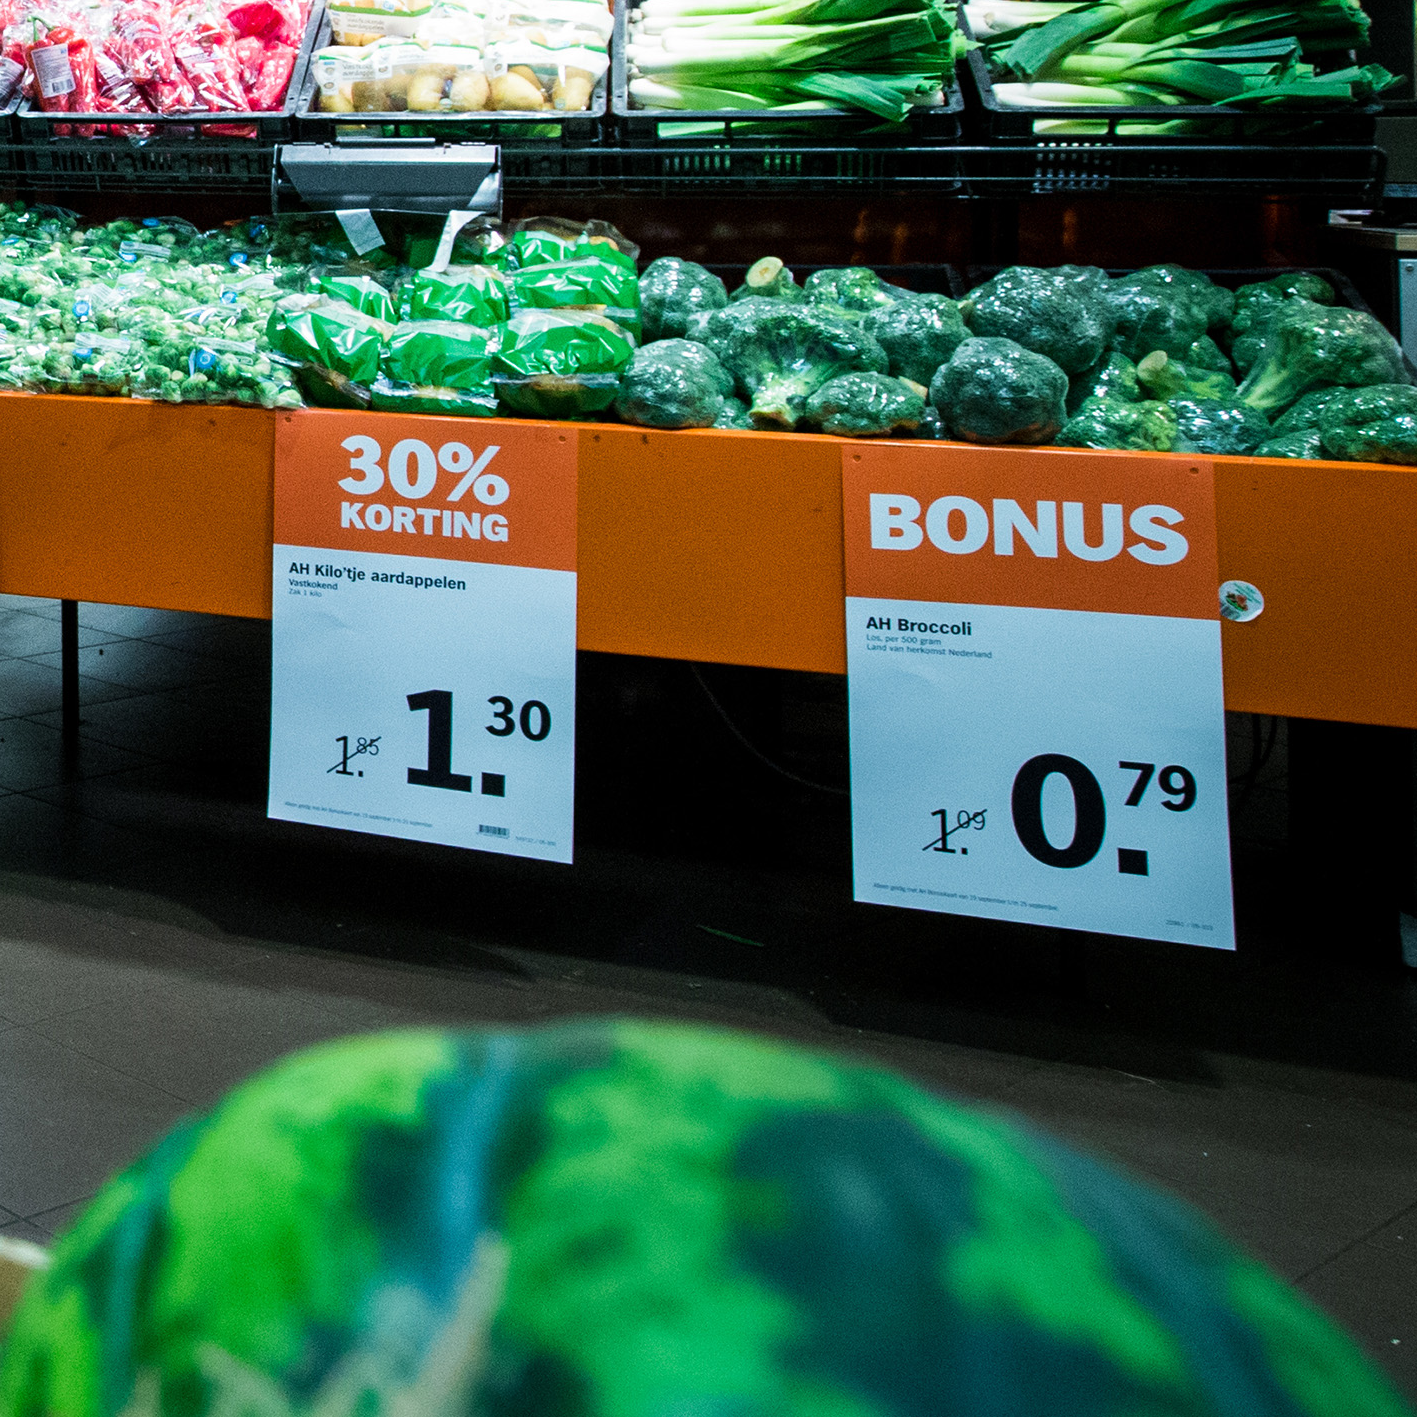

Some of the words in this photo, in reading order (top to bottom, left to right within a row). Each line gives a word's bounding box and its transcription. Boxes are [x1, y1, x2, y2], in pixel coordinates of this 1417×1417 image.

[337, 435, 510, 506] 30%
[340, 501, 510, 543] KORTING
[869, 492, 1189, 566] BONUS
[288, 578, 338, 590] Vastkokend
[289, 562, 309, 575] AH
[371, 572, 466, 590] aardappelen
[866, 616, 891, 630] AH
[898, 618, 972, 636] Broccoli
[885, 636, 899, 644] per
[901, 636, 917, 644] 500
[920, 638, 942, 646] gram
[867, 643, 887, 651] Land
[906, 646, 946, 655] herkomst
[948, 649, 992, 659] Nederland
[406, 688, 553, 798] 1.30
[1011, 753, 1197, 876] 0.79
